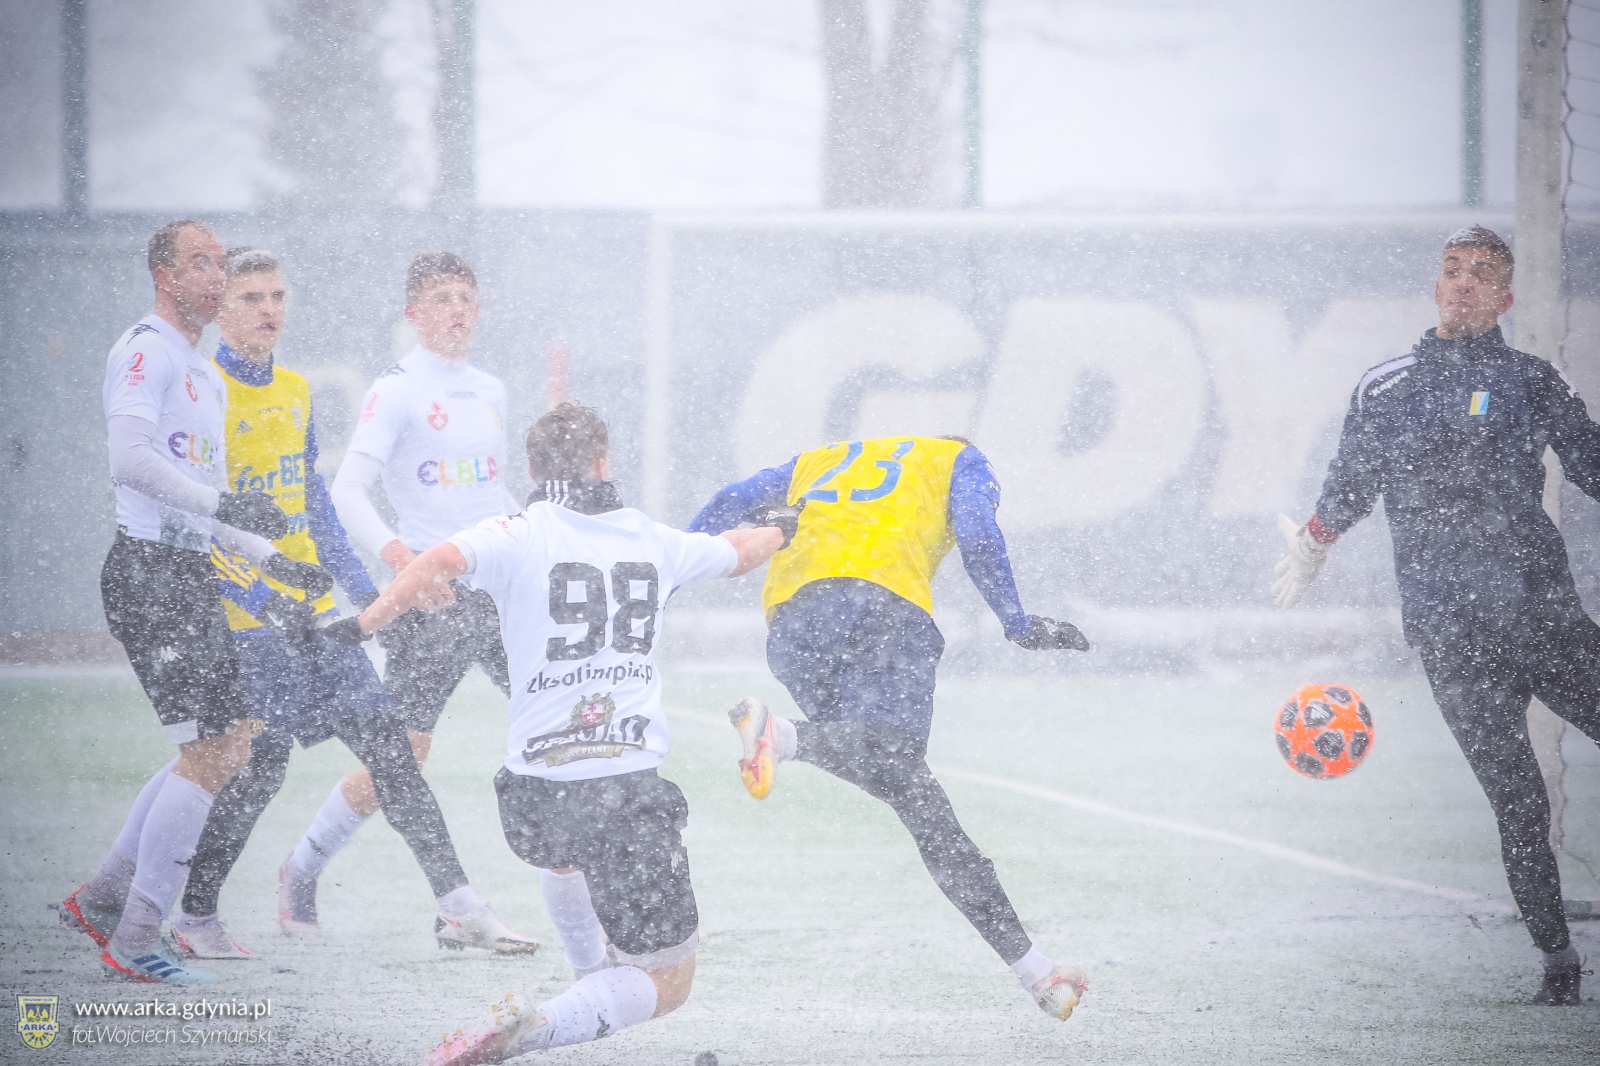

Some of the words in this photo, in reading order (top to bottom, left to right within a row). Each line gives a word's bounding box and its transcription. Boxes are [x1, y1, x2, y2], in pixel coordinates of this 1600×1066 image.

[129, 352, 144, 373] 2
[735, 292, 1600, 527] GDY
[801, 440, 915, 504] 23
[546, 561, 659, 662] 98
[526, 661, 653, 694] zksolimpia.p
